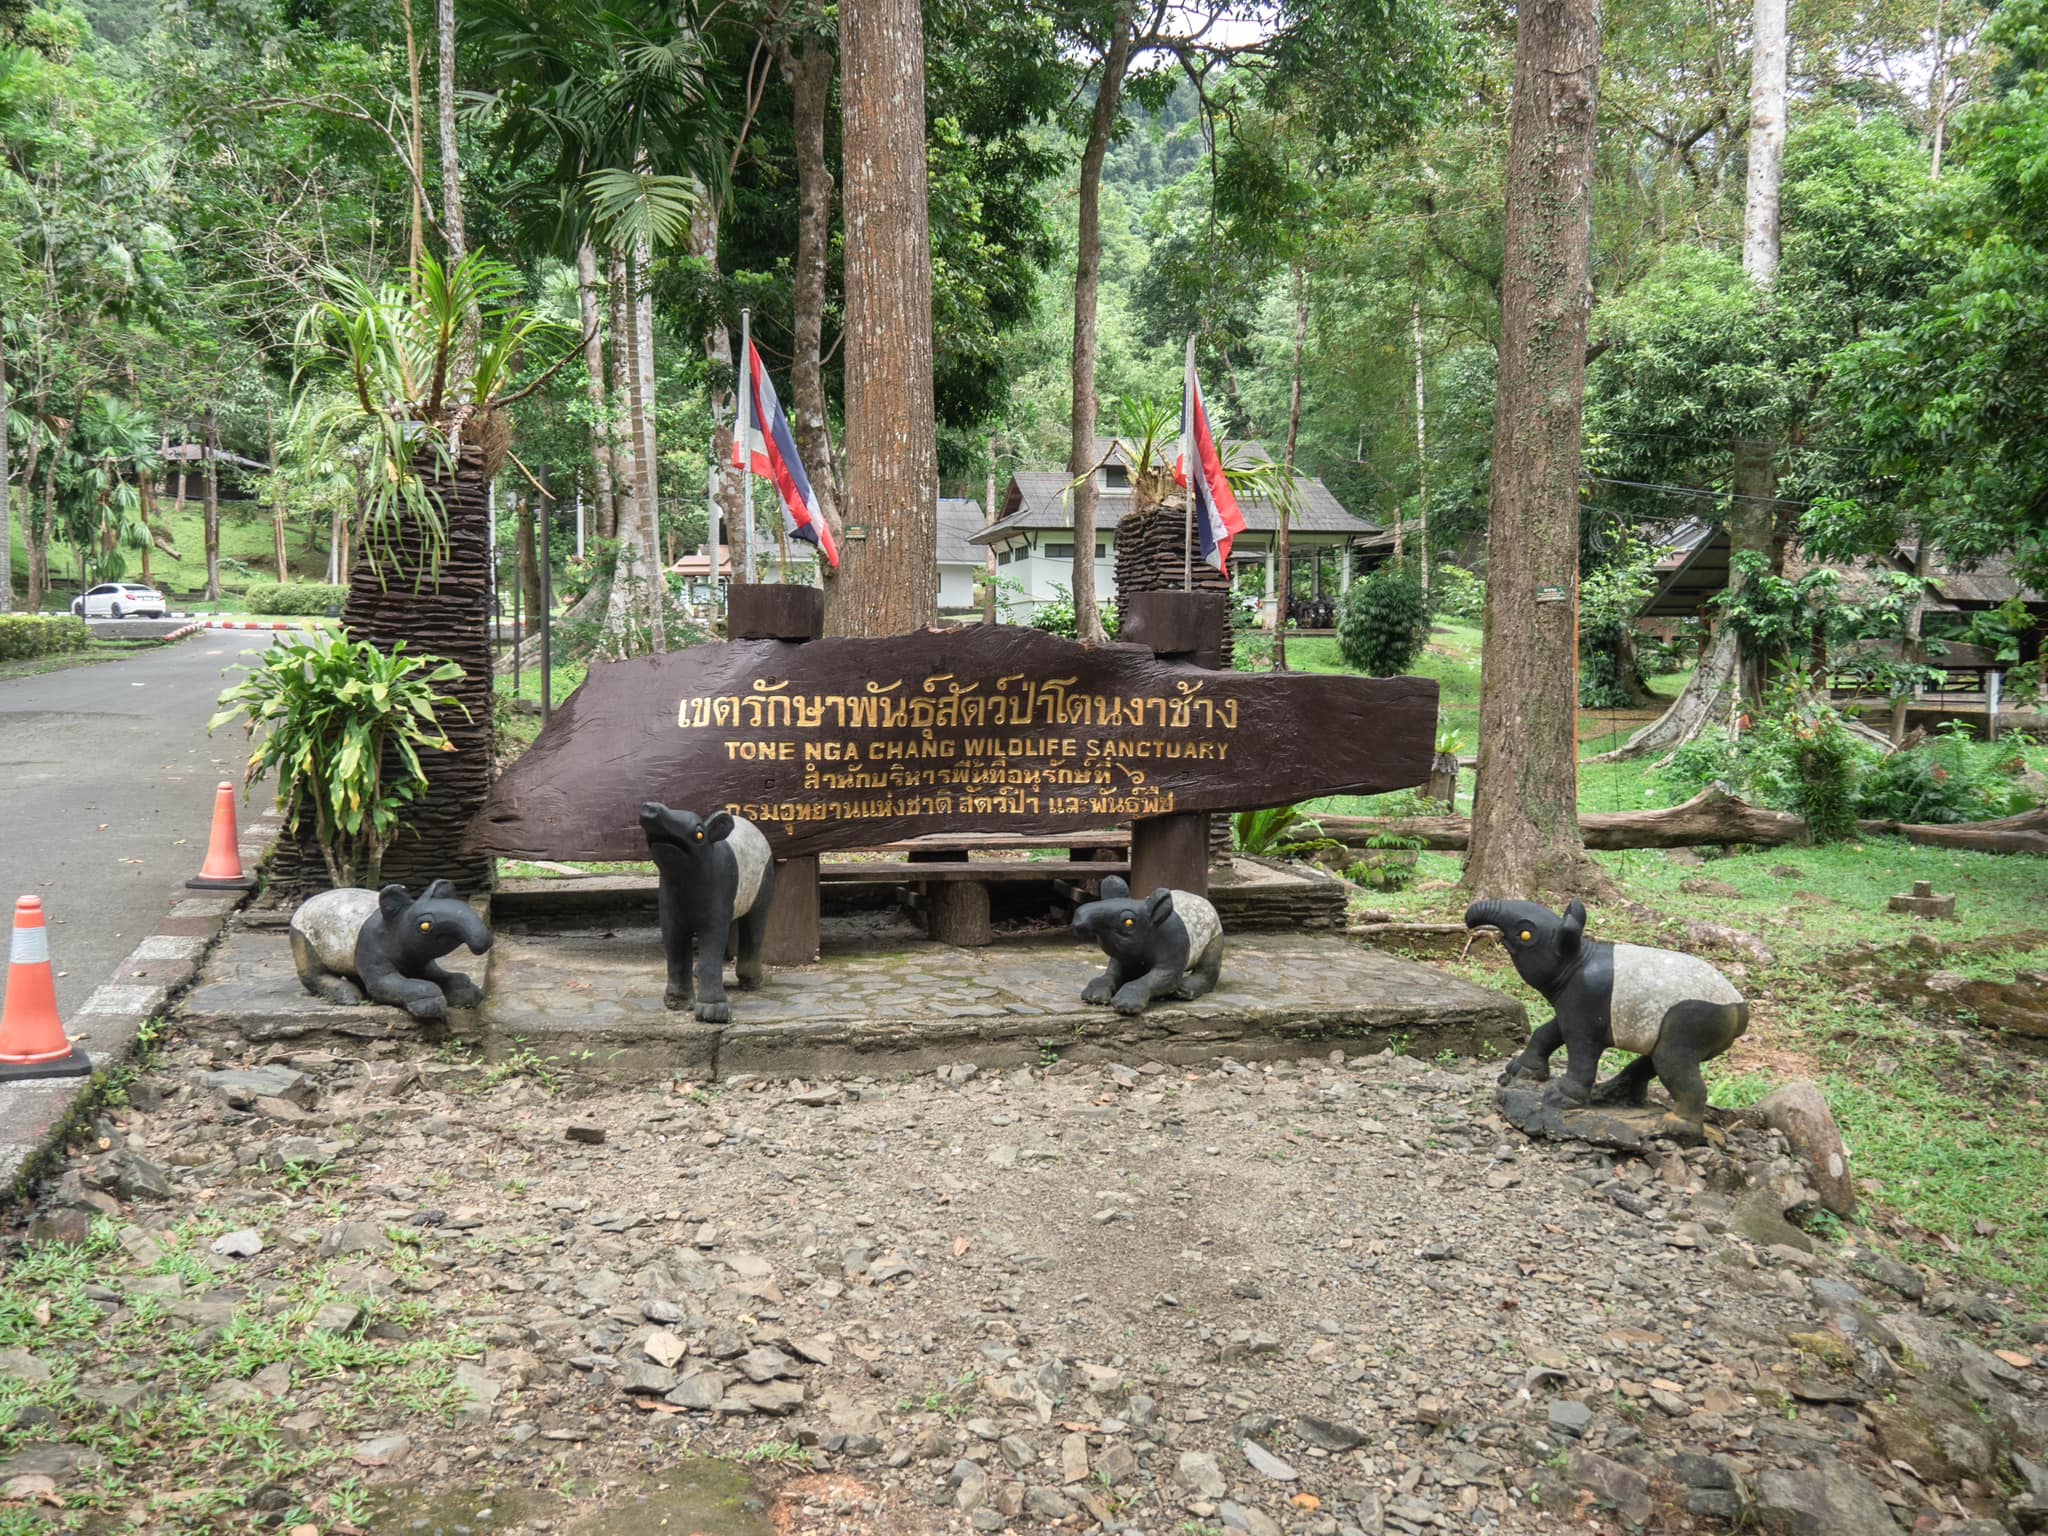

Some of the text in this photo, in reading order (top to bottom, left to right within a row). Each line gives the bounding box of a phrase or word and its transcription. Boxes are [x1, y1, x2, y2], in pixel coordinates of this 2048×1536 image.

[678, 673, 1238, 739] เขตรักษาพันธุ์สัตว์ป่าโตนงาช้าง
[724, 738, 1229, 761] TONE NGA CHANG WILDLIFE SANCTUARY
[959, 785, 1040, 814] สัตว์ป่า
